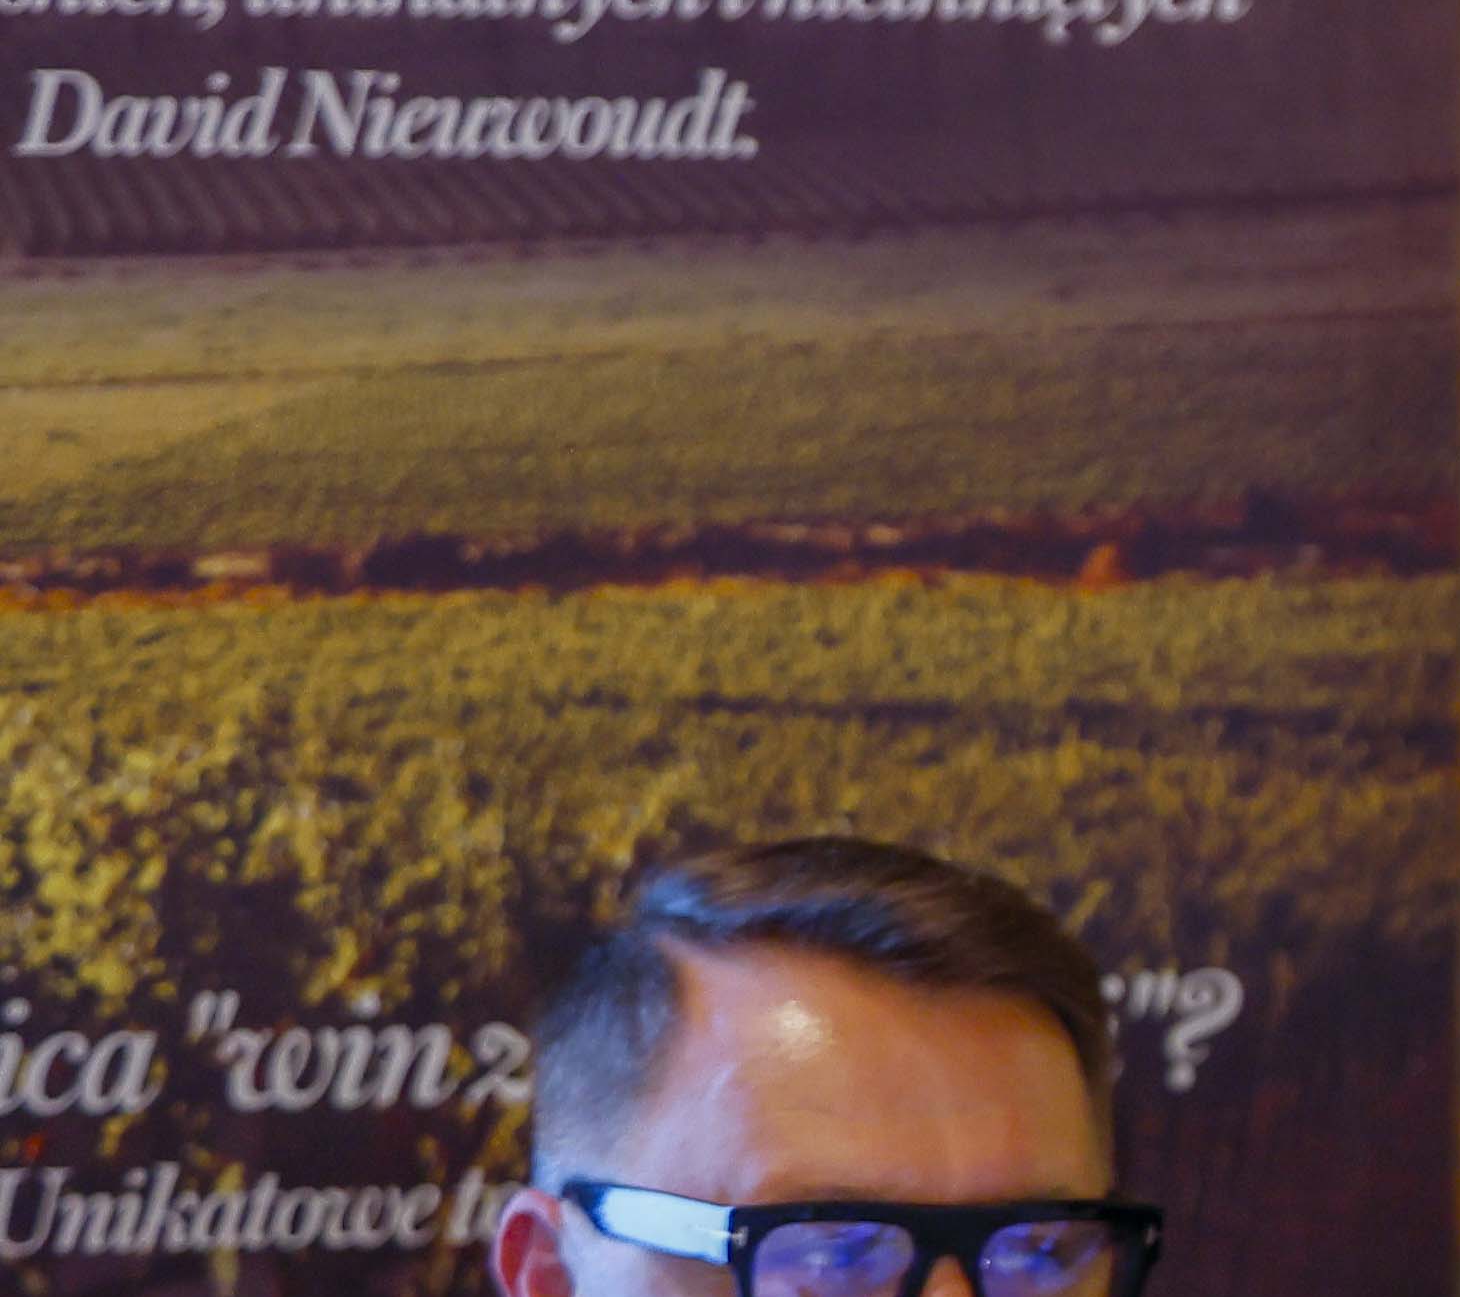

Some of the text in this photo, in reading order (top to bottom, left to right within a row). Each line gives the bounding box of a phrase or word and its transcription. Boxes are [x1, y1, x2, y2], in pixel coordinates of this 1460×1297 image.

[12, 66, 759, 160] David Nieuwoudt.
[0, 1161, 443, 1259] Unikatowe
